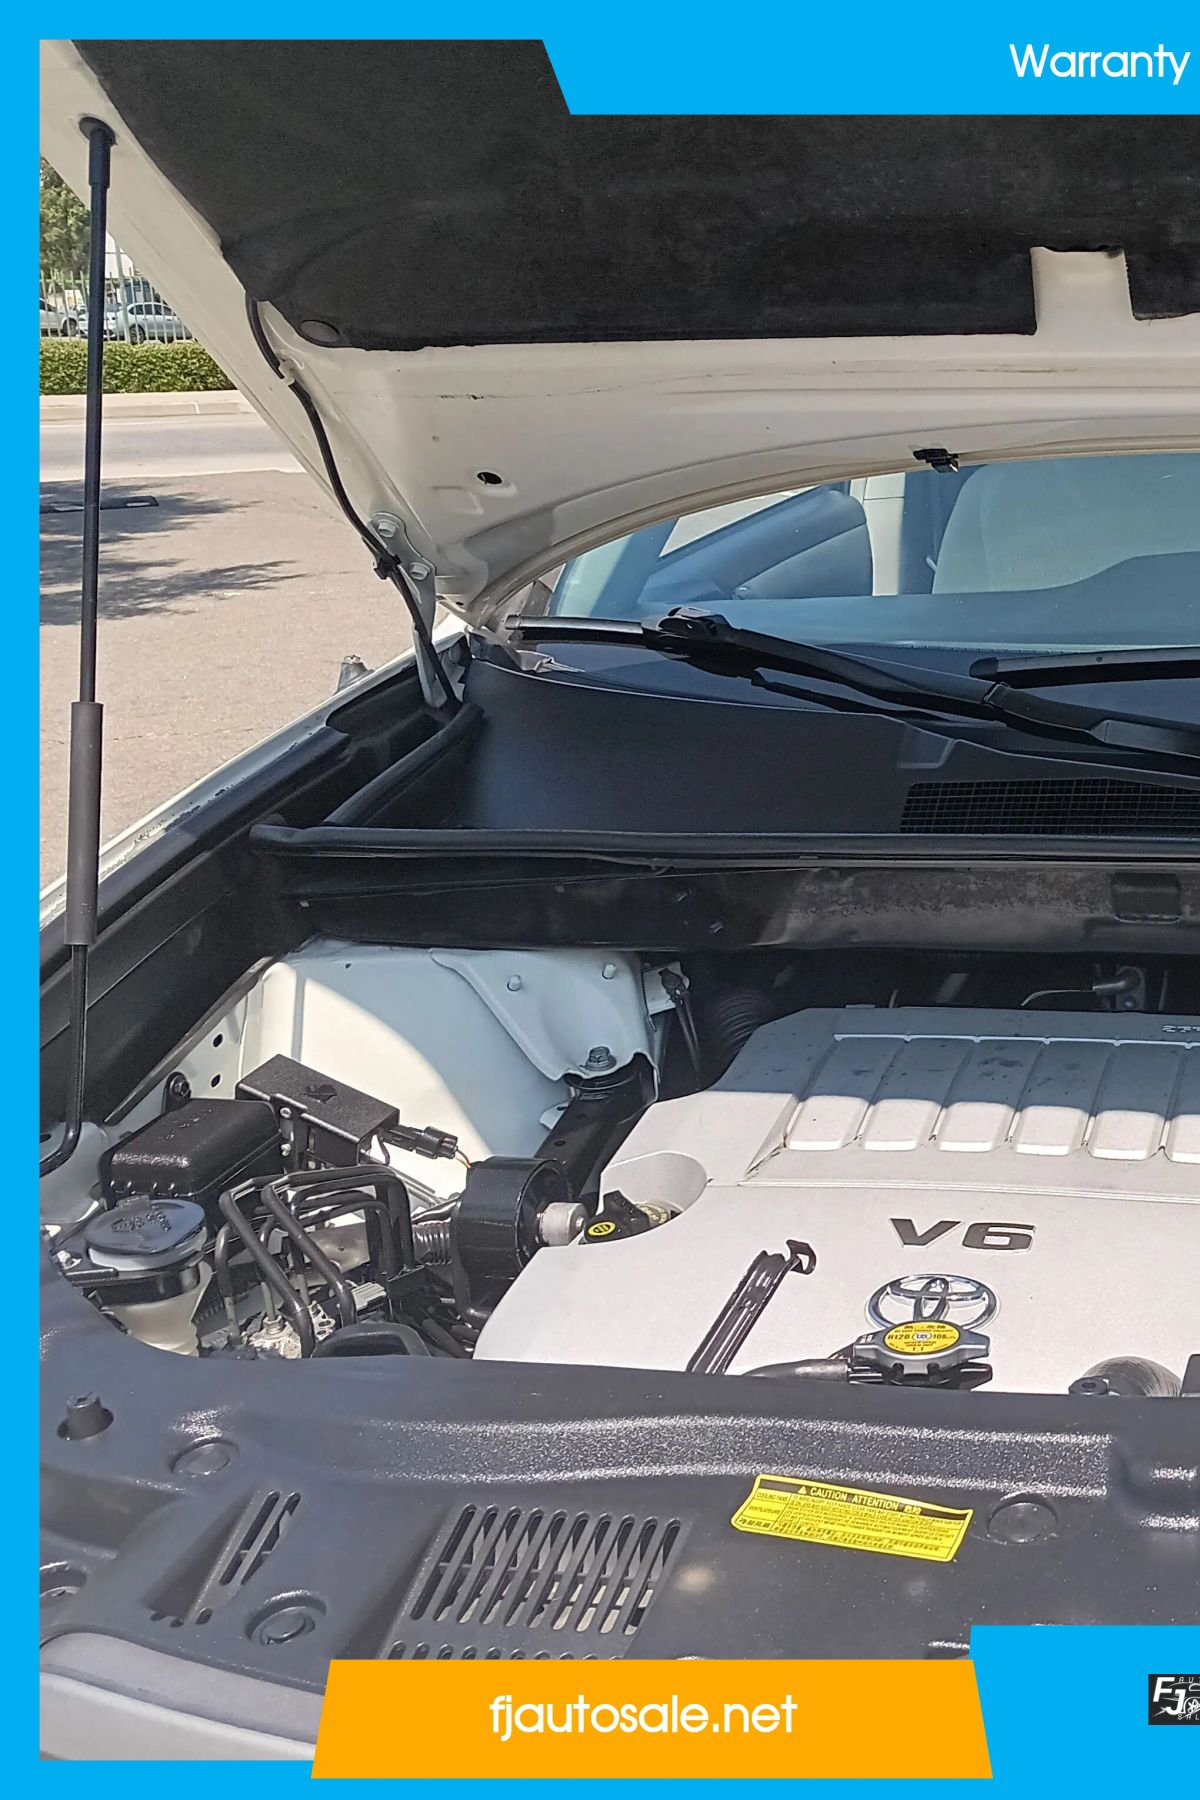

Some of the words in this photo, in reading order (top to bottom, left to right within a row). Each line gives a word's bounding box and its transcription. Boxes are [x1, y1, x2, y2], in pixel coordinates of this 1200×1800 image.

[890, 1217, 1036, 1251] V6
[810, 1487, 848, 1501] CAUTION
[851, 1494, 899, 1511] ATTENTION
